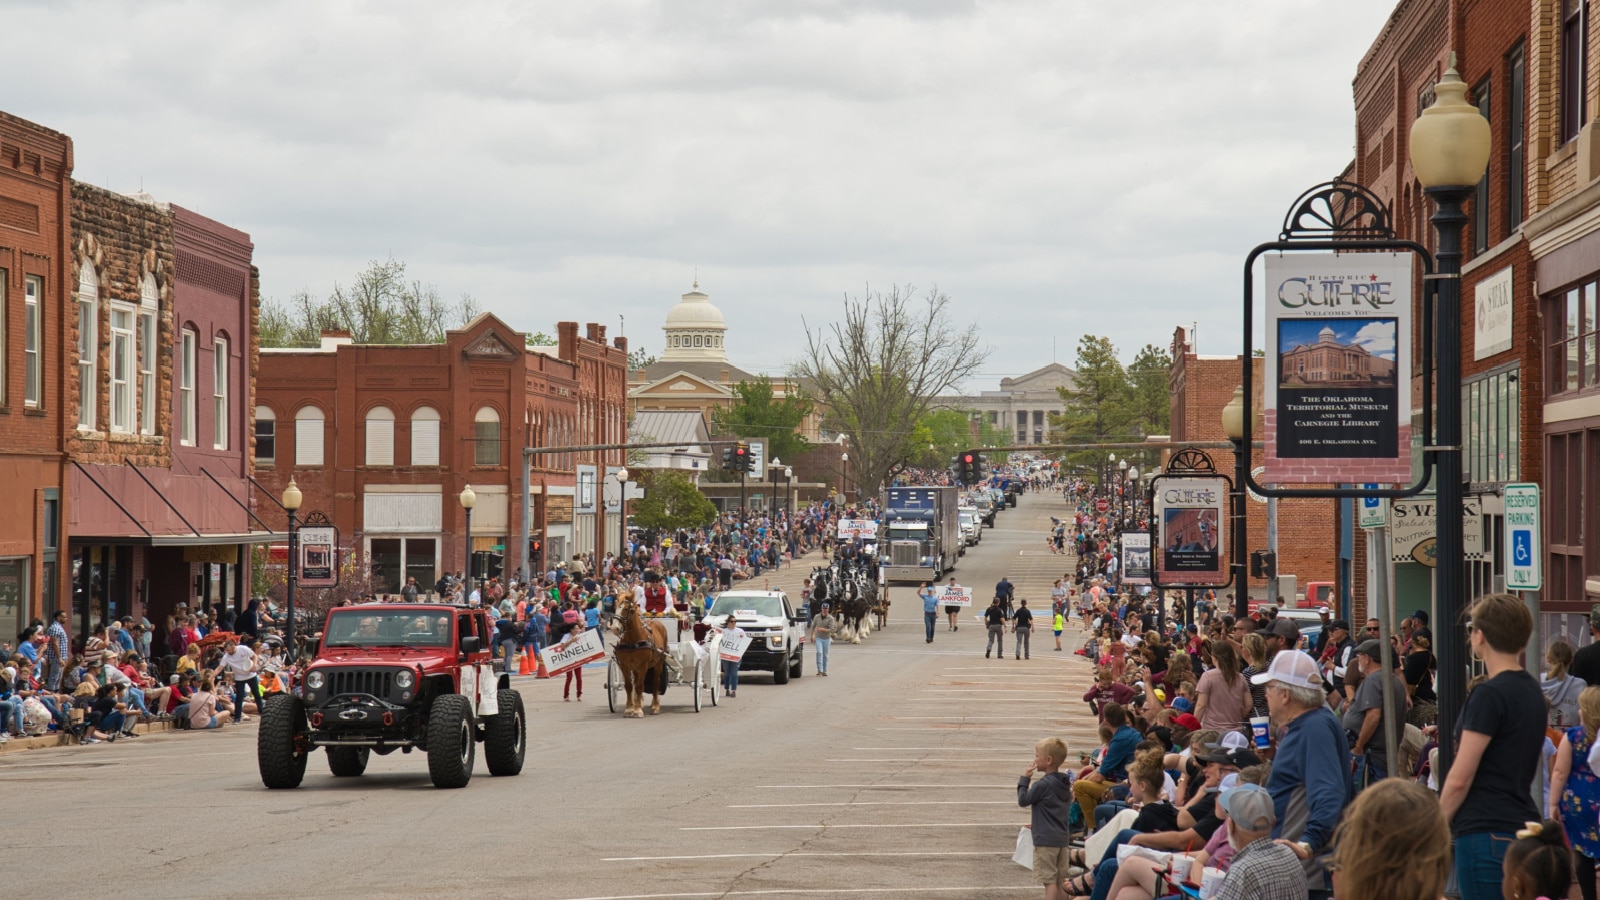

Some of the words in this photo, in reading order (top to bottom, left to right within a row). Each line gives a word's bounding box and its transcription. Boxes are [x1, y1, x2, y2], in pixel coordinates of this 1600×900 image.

[1278, 277, 1397, 309] GUTHRIE
[1164, 489, 1217, 504] GUTHRIE
[1507, 494, 1536, 507] RESERVED
[1508, 512, 1535, 526] PARKING
[1513, 569, 1531, 583] ONLY
[551, 643, 595, 664] PINNELL
